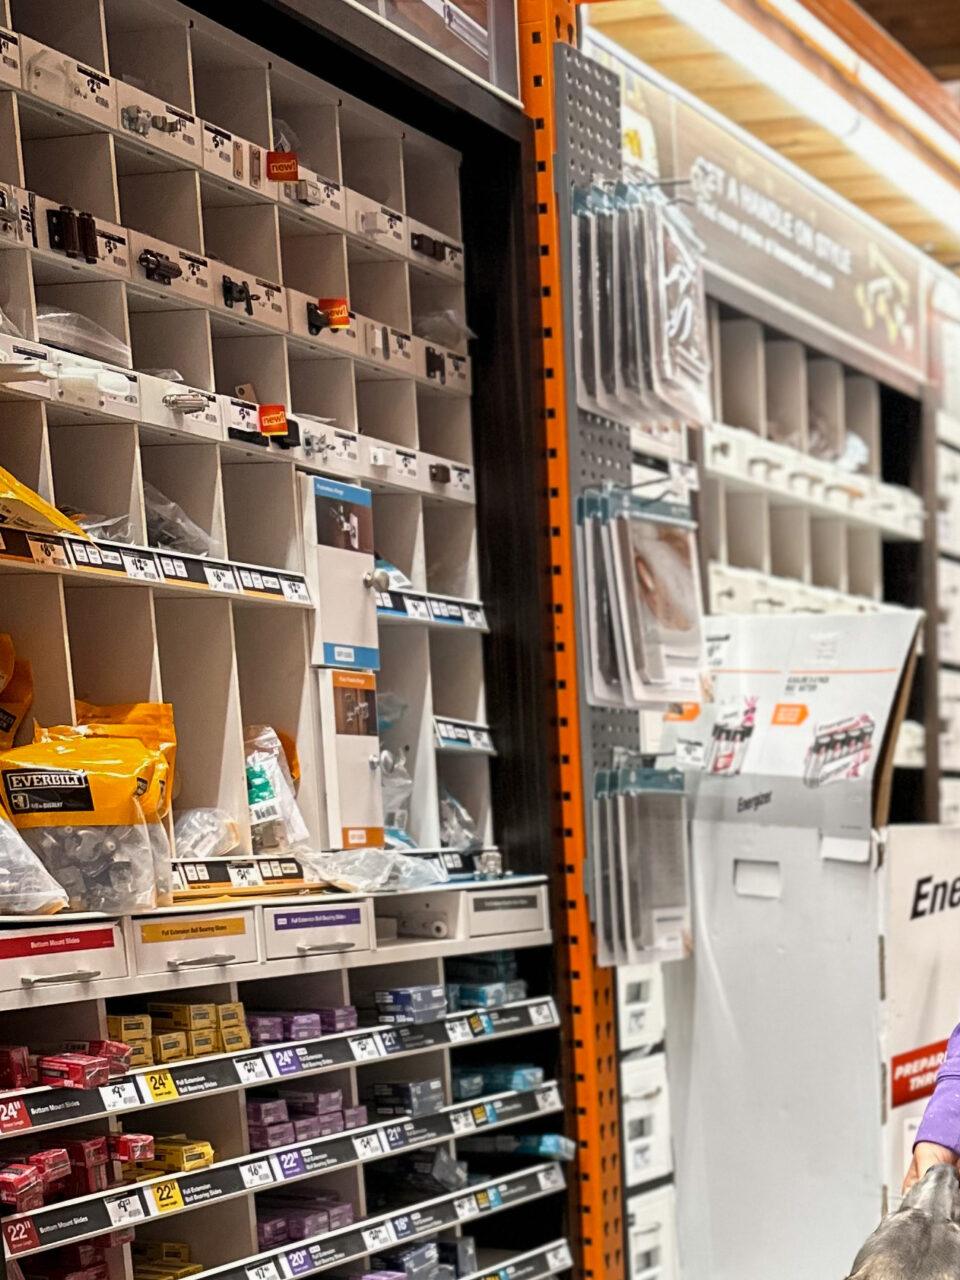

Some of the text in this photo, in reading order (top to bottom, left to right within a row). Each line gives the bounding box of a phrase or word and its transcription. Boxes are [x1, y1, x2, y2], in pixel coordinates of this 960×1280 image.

[271, 160, 297, 174] new!
[263, 412, 286, 426] new!
[12, 774, 80, 788] EVERBILT
[30, 941, 49, 949] Bottom
[276, 1049, 293, 1067] 24"
[150, 1072, 168, 1091] 24"
[0, 1101, 21, 1121] 24"
[30, 1100, 80, 1115] Bottom Mount Slides
[280, 1152, 299, 1169] 22"
[156, 1182, 176, 1201] 22"
[7, 1220, 31, 1241] 22"
[39, 1216, 89, 1234] Bottom Mount Slides
[289, 1250, 307, 1267] 20"
